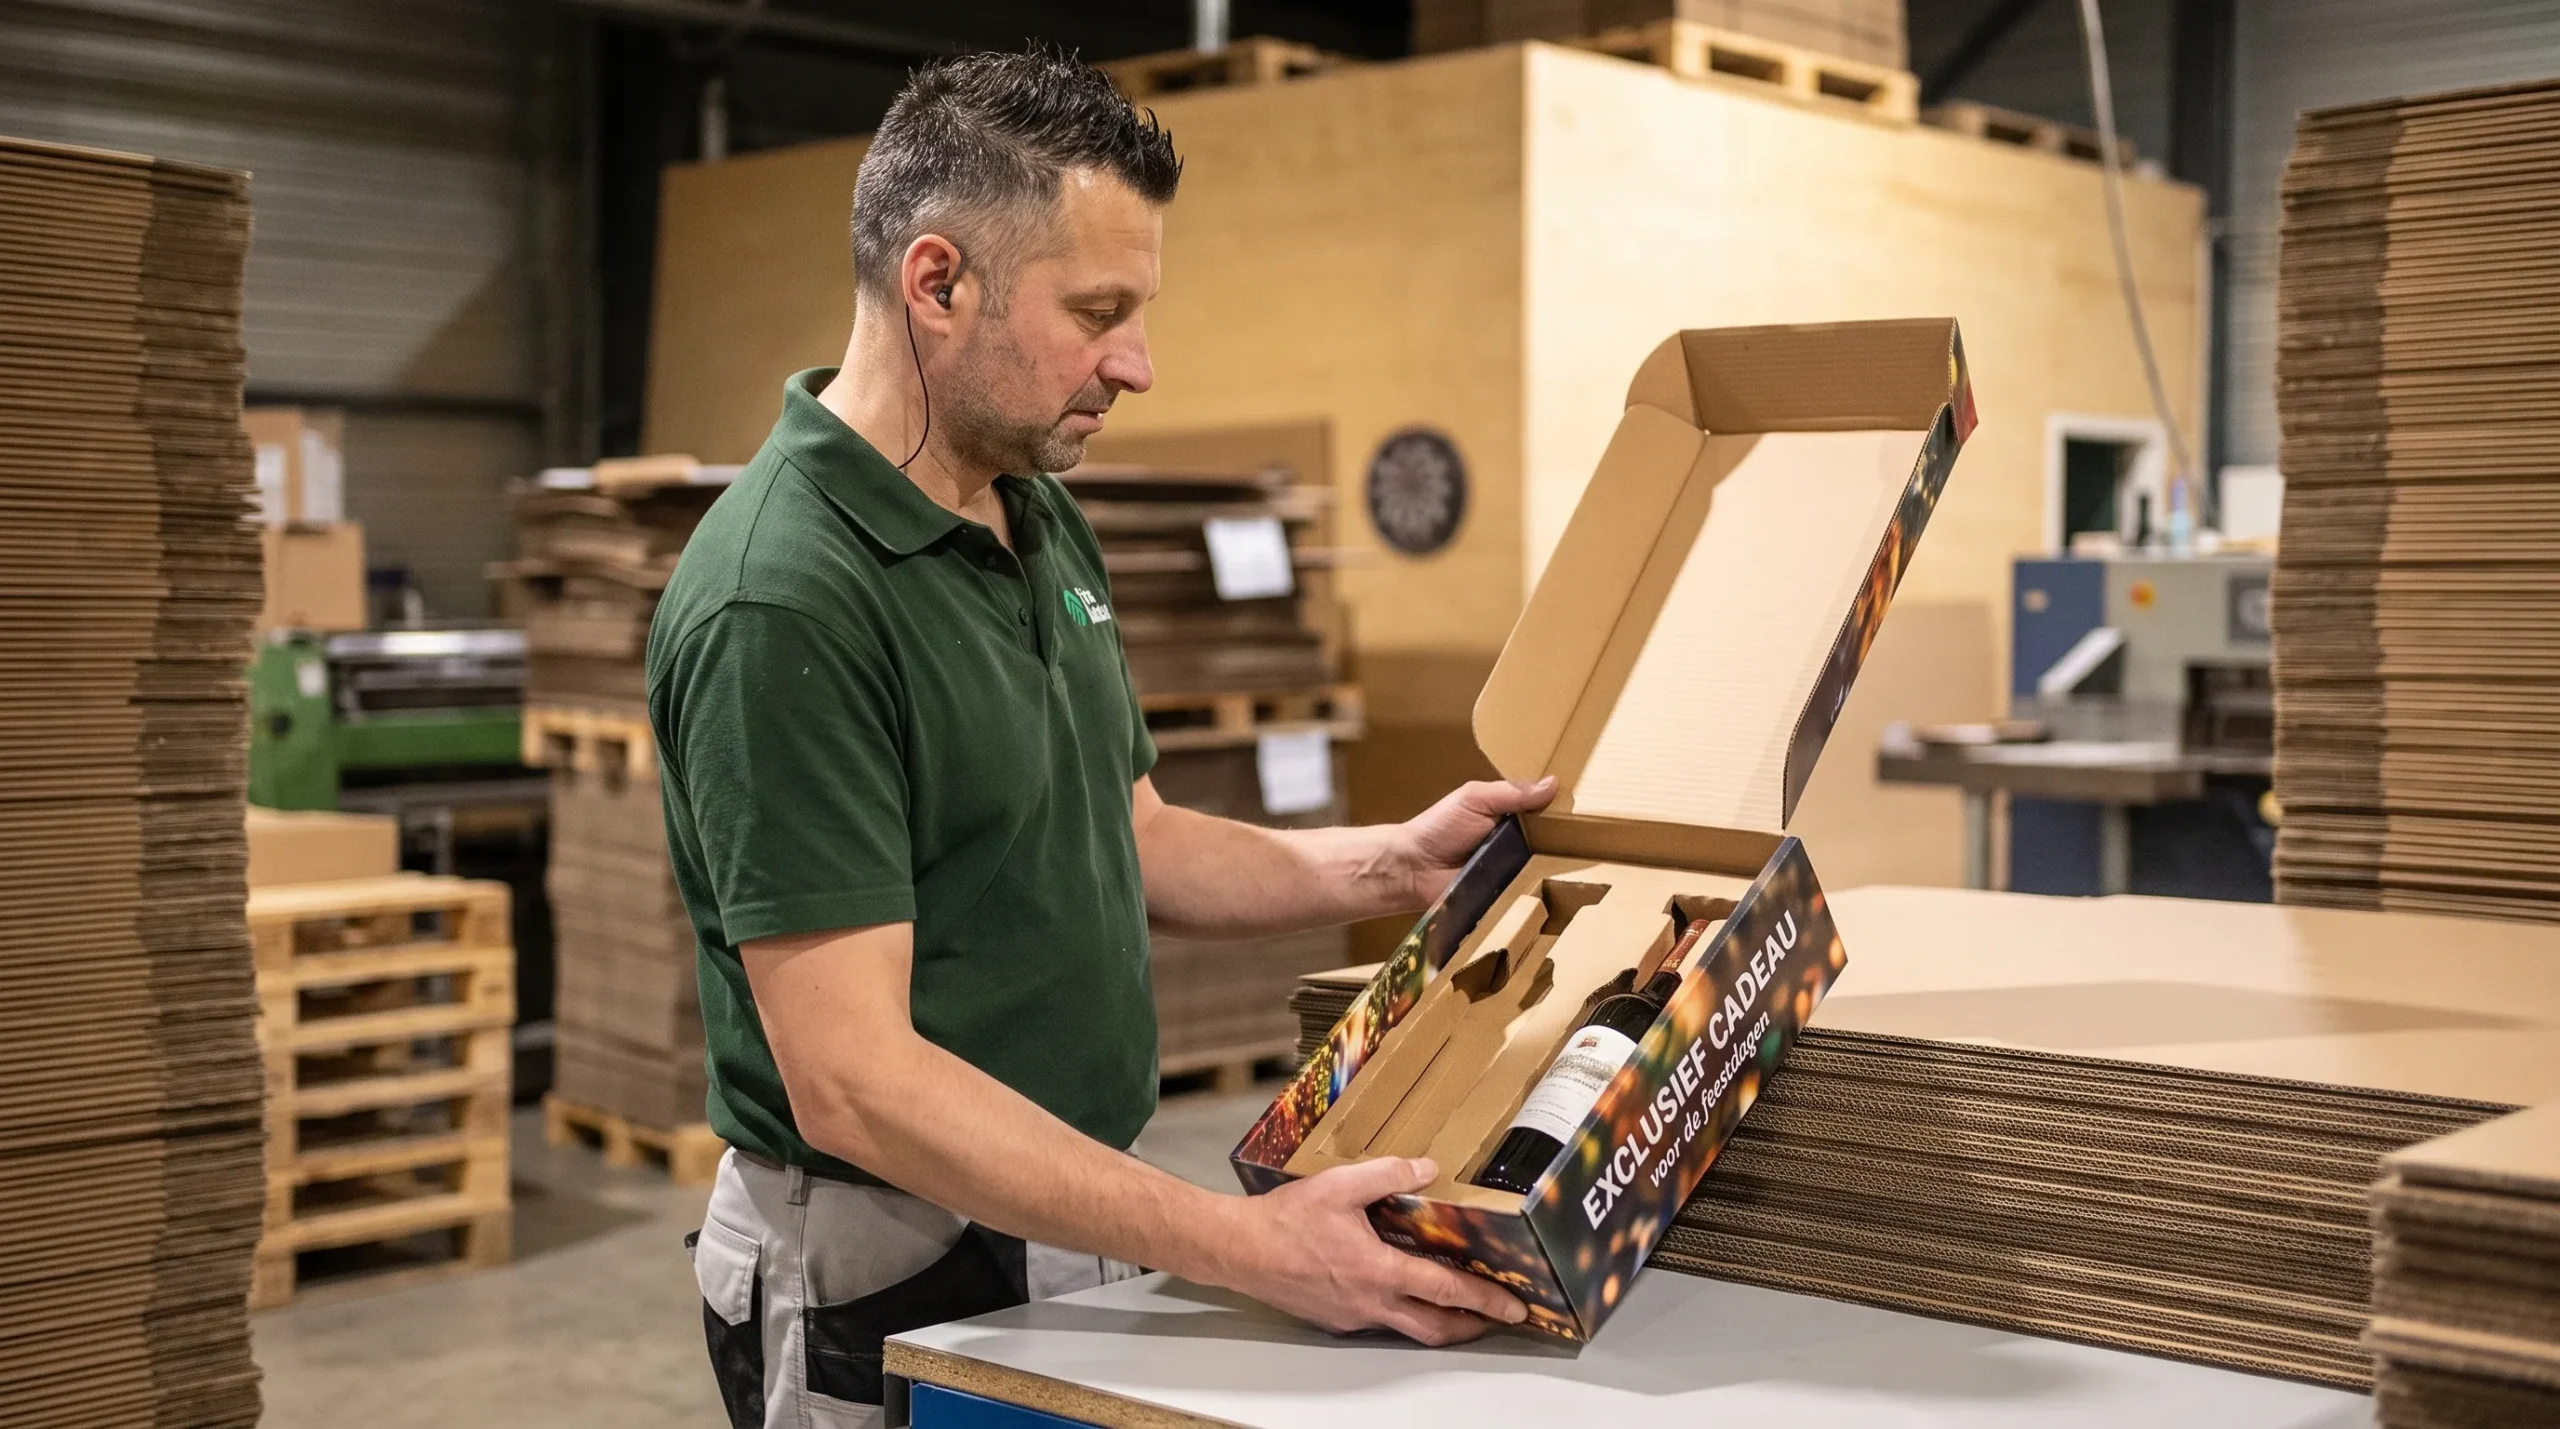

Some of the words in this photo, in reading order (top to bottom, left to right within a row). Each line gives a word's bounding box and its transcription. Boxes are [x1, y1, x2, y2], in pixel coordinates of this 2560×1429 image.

[1582, 1036, 1707, 1231] EXCLUSIEF
[1708, 909, 1797, 1050] CADEAU
[1650, 1137, 1681, 1188] voor
[1684, 1111, 1701, 1143] de
[1701, 1011, 1770, 1124] feestdagen
